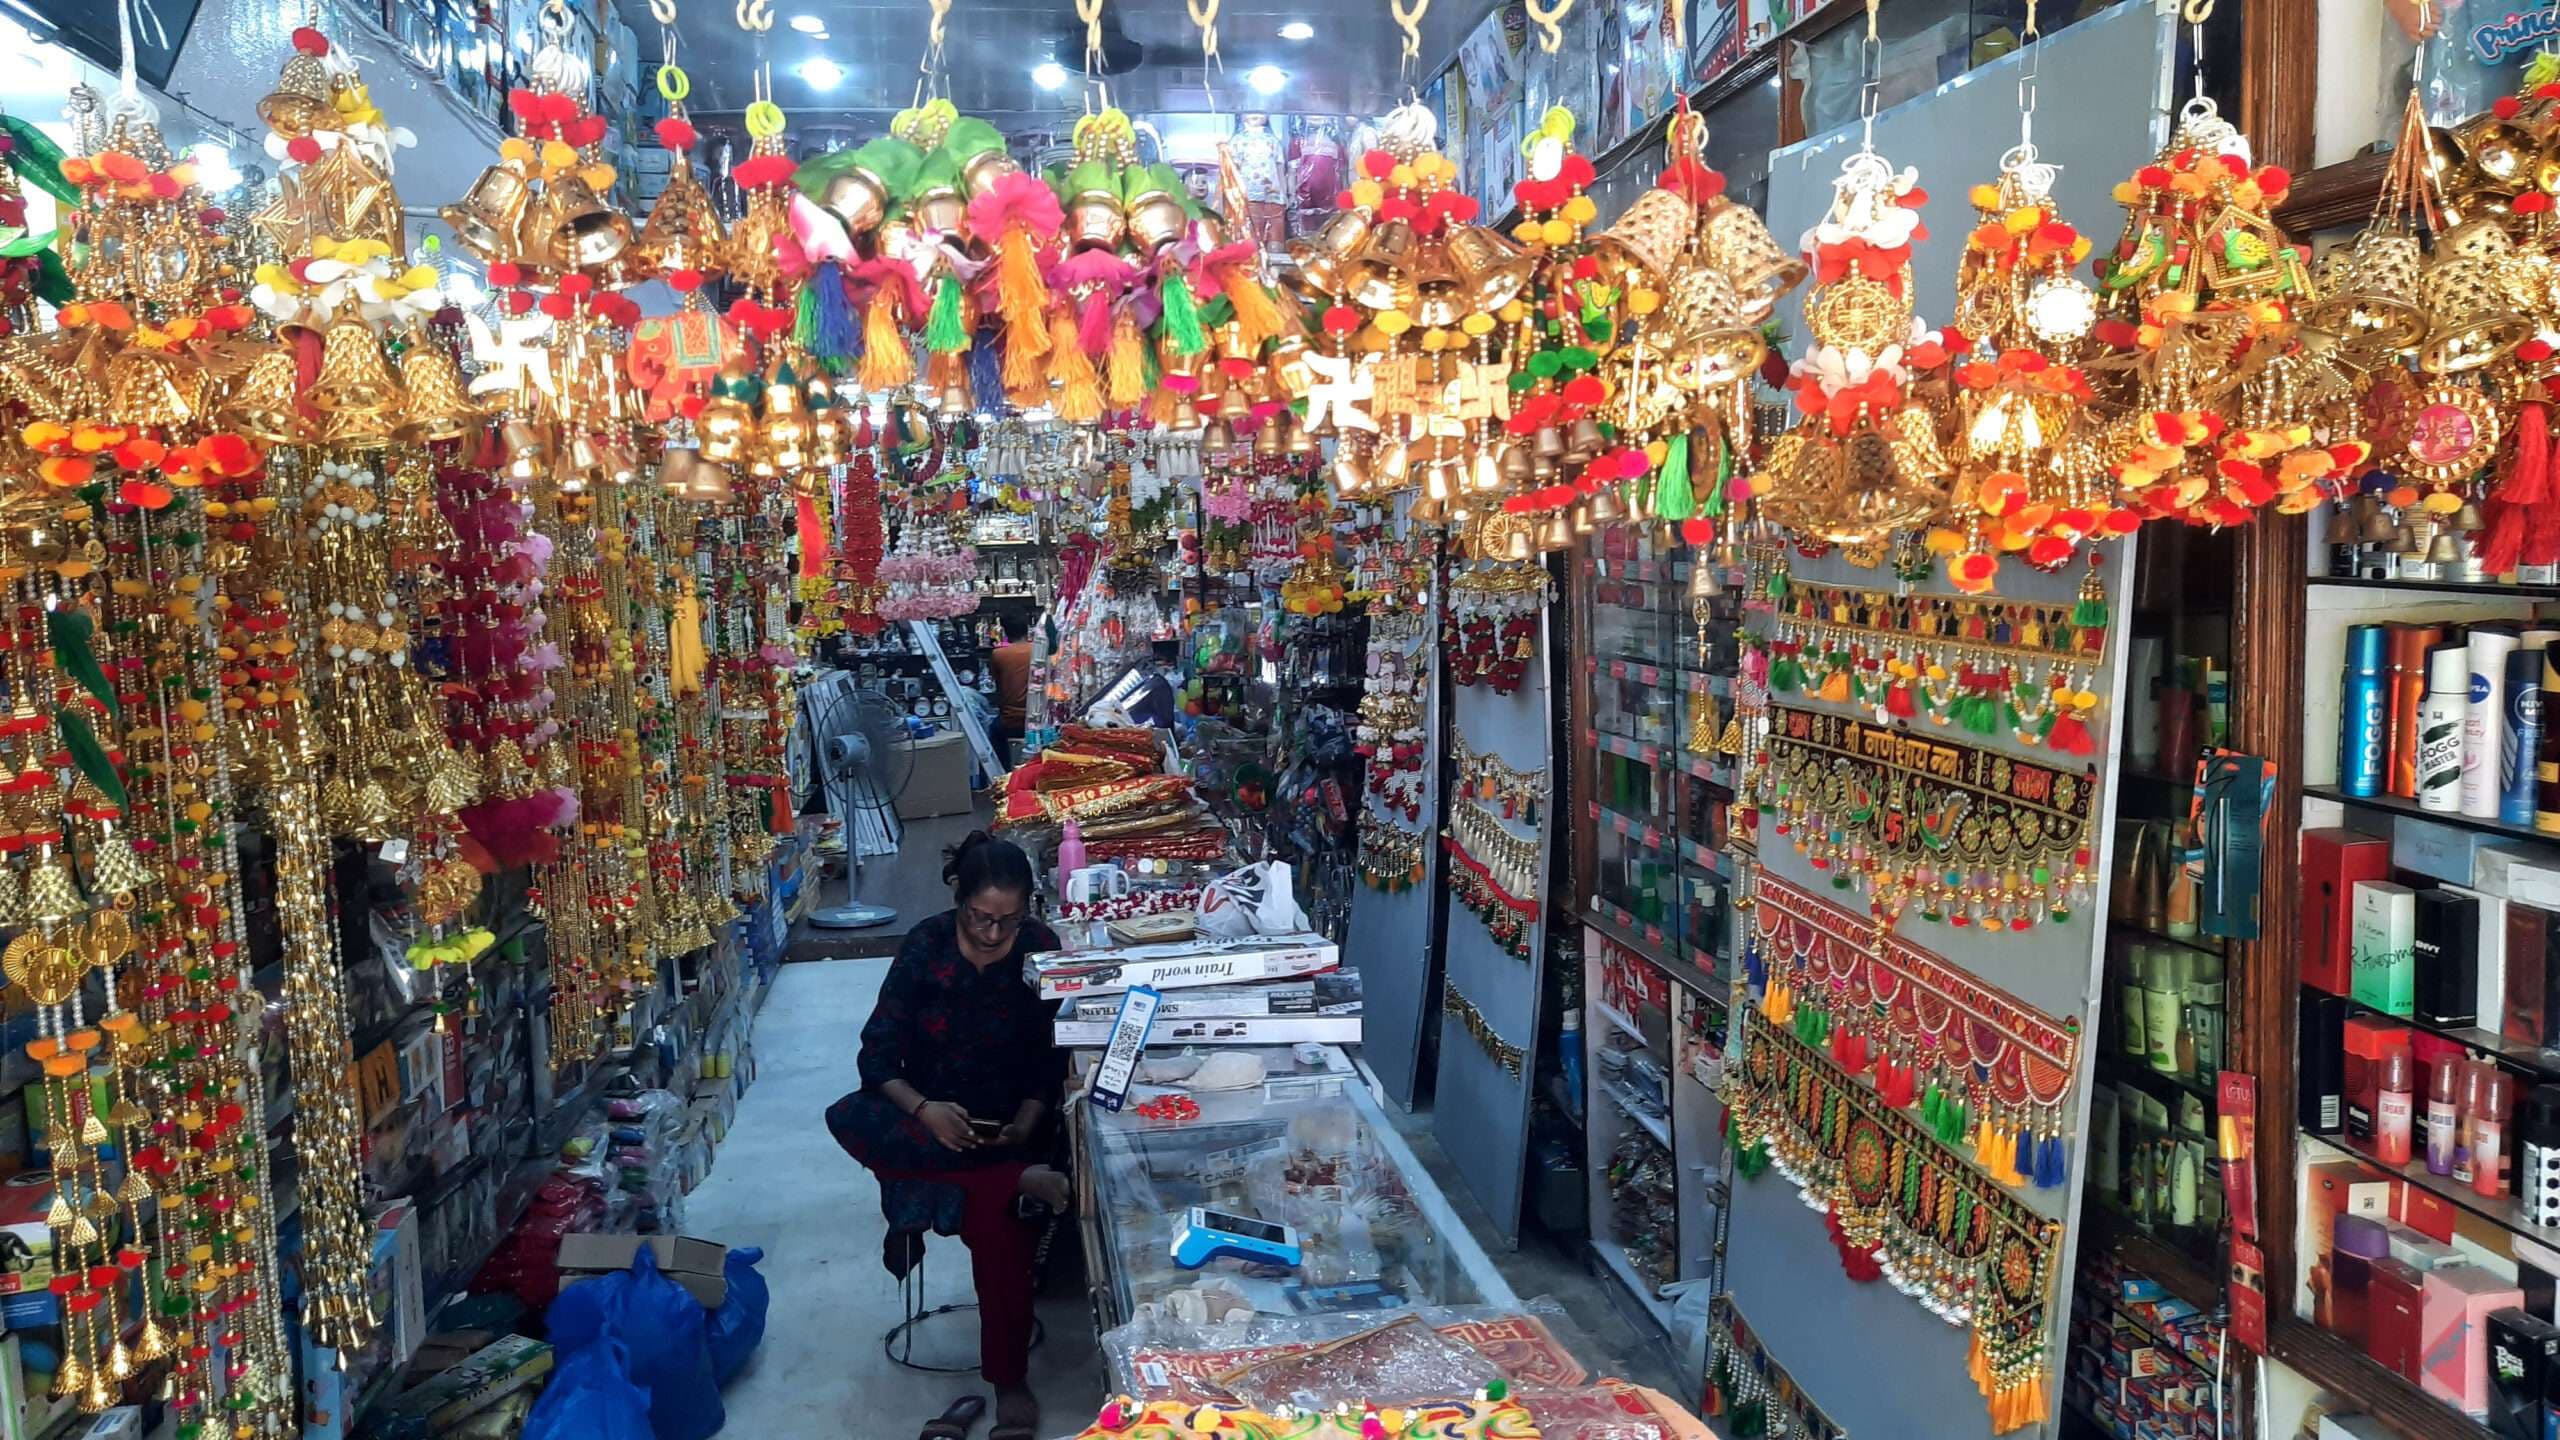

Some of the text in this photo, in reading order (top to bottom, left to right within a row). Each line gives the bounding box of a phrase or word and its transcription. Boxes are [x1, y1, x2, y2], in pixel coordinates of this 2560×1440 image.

[2474, 9, 2560, 58] Princ
[1152, 962, 1235, 981] Train world
[1204, 1167, 1246, 1184] CASIO
